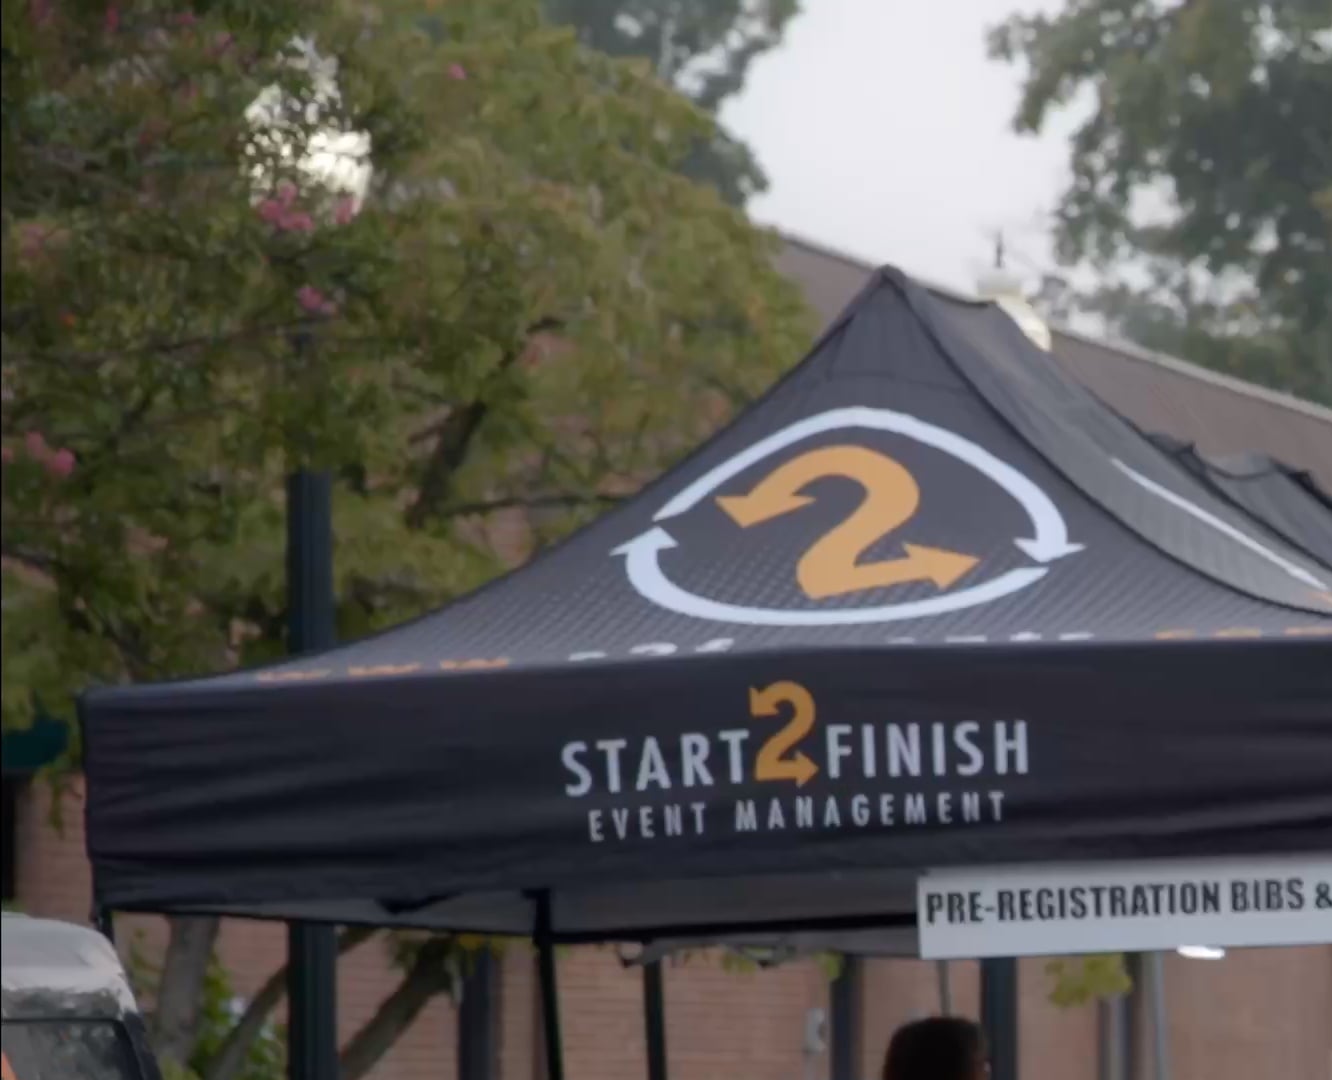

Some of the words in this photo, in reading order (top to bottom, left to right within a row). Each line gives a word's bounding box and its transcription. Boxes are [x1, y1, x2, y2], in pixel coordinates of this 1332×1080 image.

[589, 802, 707, 843] EVENT
[735, 791, 1005, 832] MANAGEMENT
[925, 881, 1220, 925] PRE-REGISTRATION
[1231, 878, 1305, 915] BIBS
